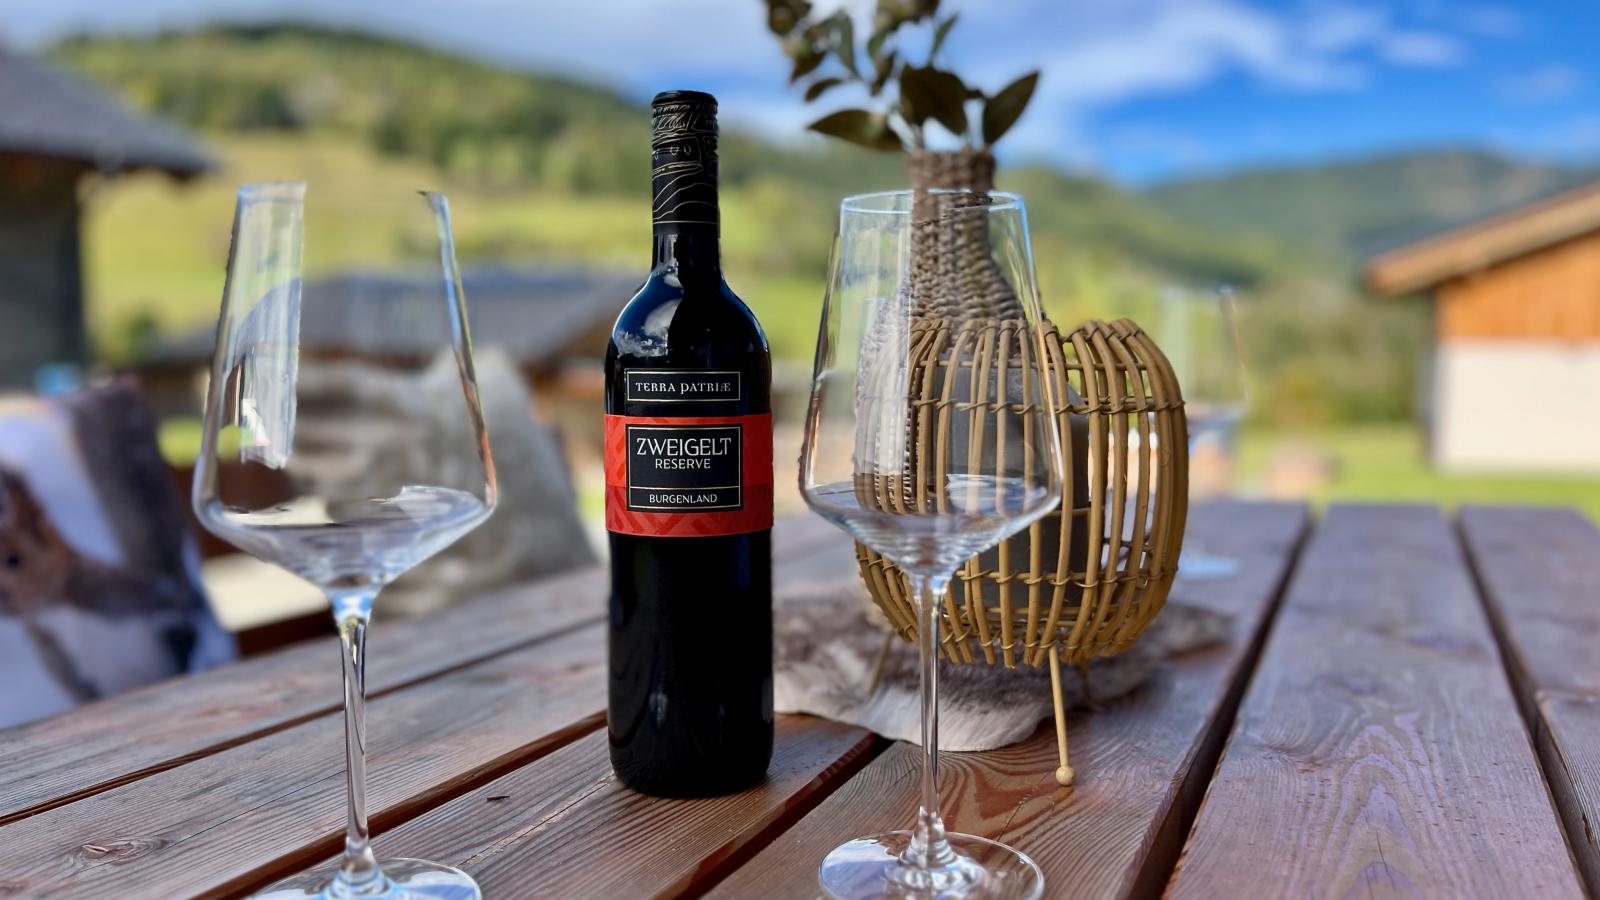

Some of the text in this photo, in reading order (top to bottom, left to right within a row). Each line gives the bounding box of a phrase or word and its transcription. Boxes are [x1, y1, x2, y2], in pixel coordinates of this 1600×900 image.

[635, 382, 676, 392] TERRA
[636, 437, 732, 456] ZWEIGELT
[655, 458, 711, 469] RESERVE
[649, 494, 718, 504] BURGENLAND
